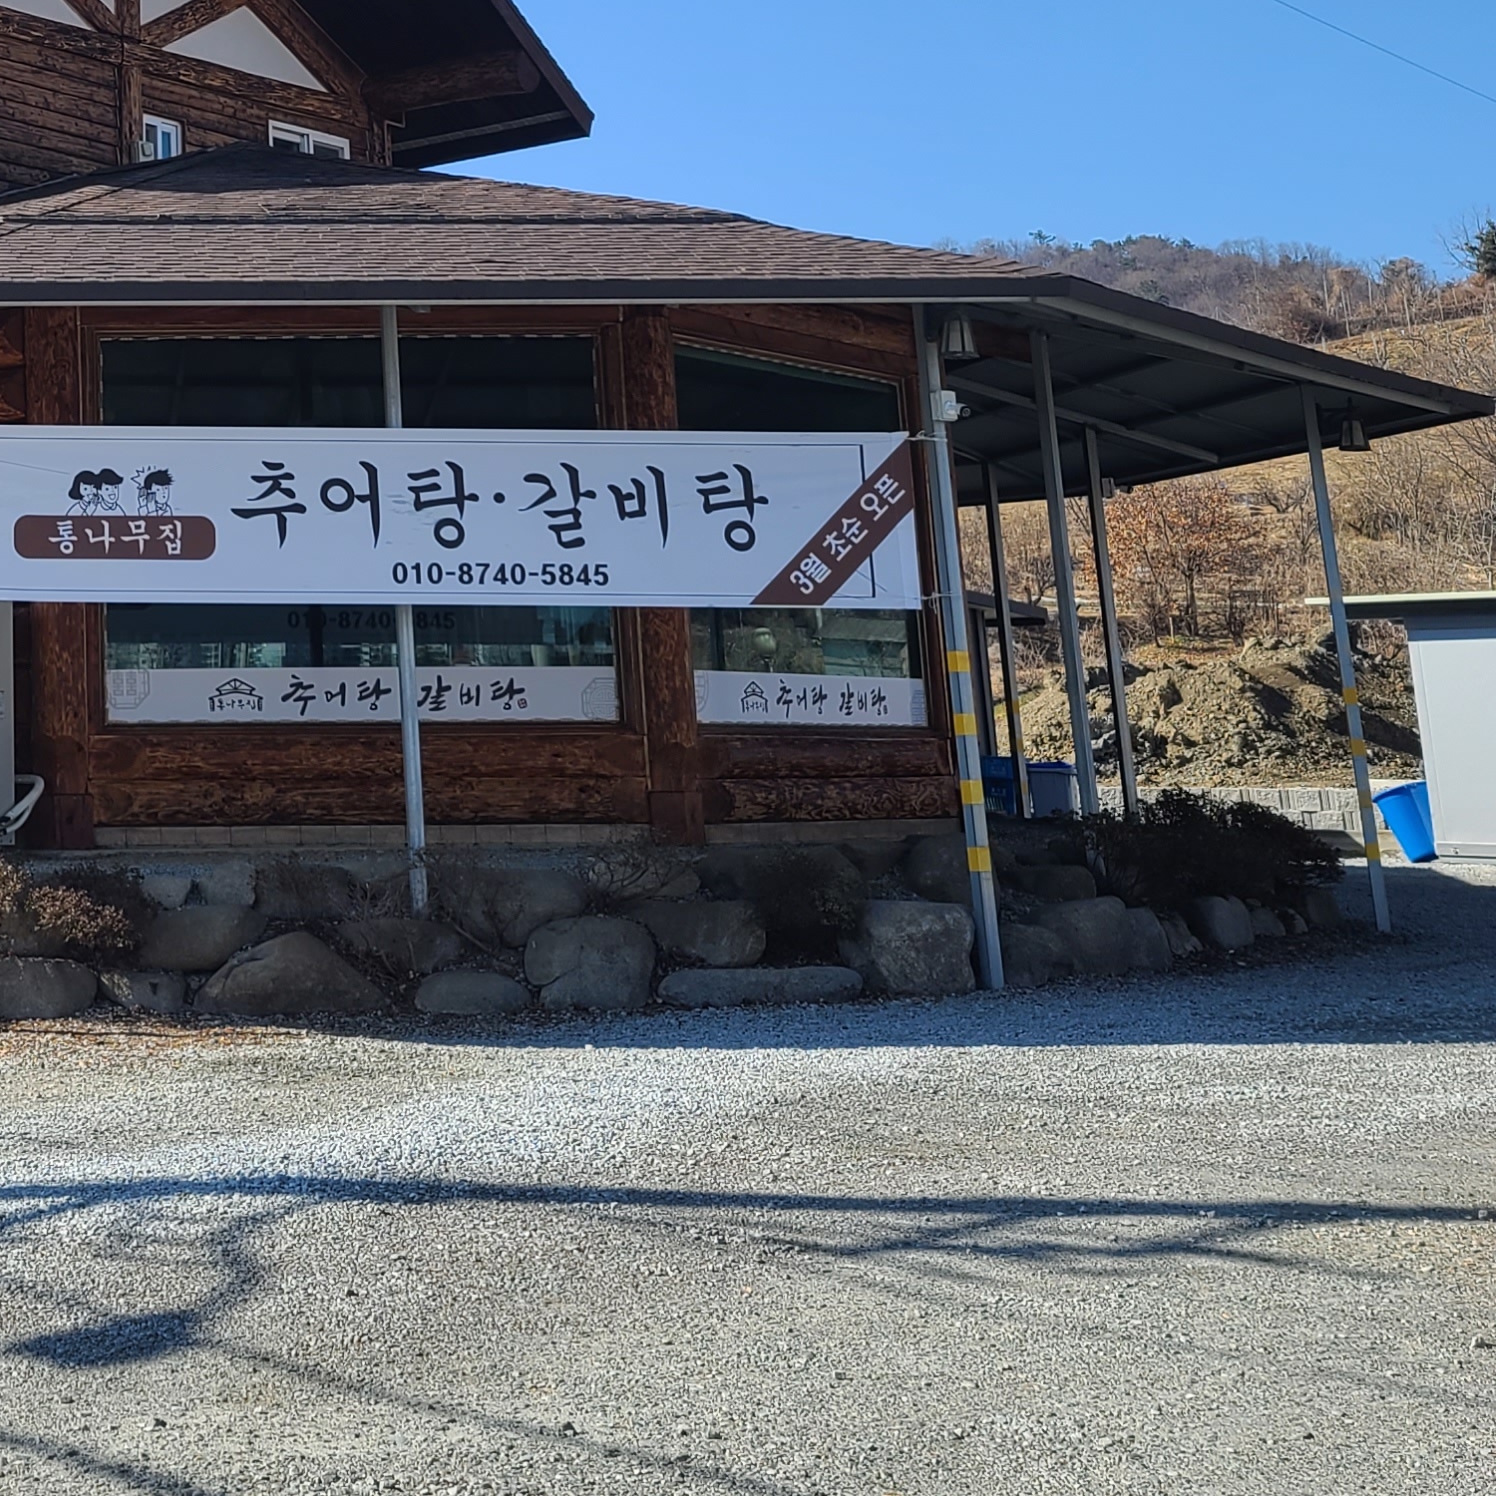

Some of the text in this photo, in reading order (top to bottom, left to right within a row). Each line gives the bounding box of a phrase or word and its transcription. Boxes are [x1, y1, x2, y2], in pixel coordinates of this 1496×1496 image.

[47, 519, 183, 555] 통나무집
[789, 473, 906, 595] 3월 초순 오픈
[391, 562, 610, 587] 010-8740-5845
[280, 674, 525, 716] 추어탕 갈비탕
[775, 678, 886, 719] 추어탕 갈비탕
